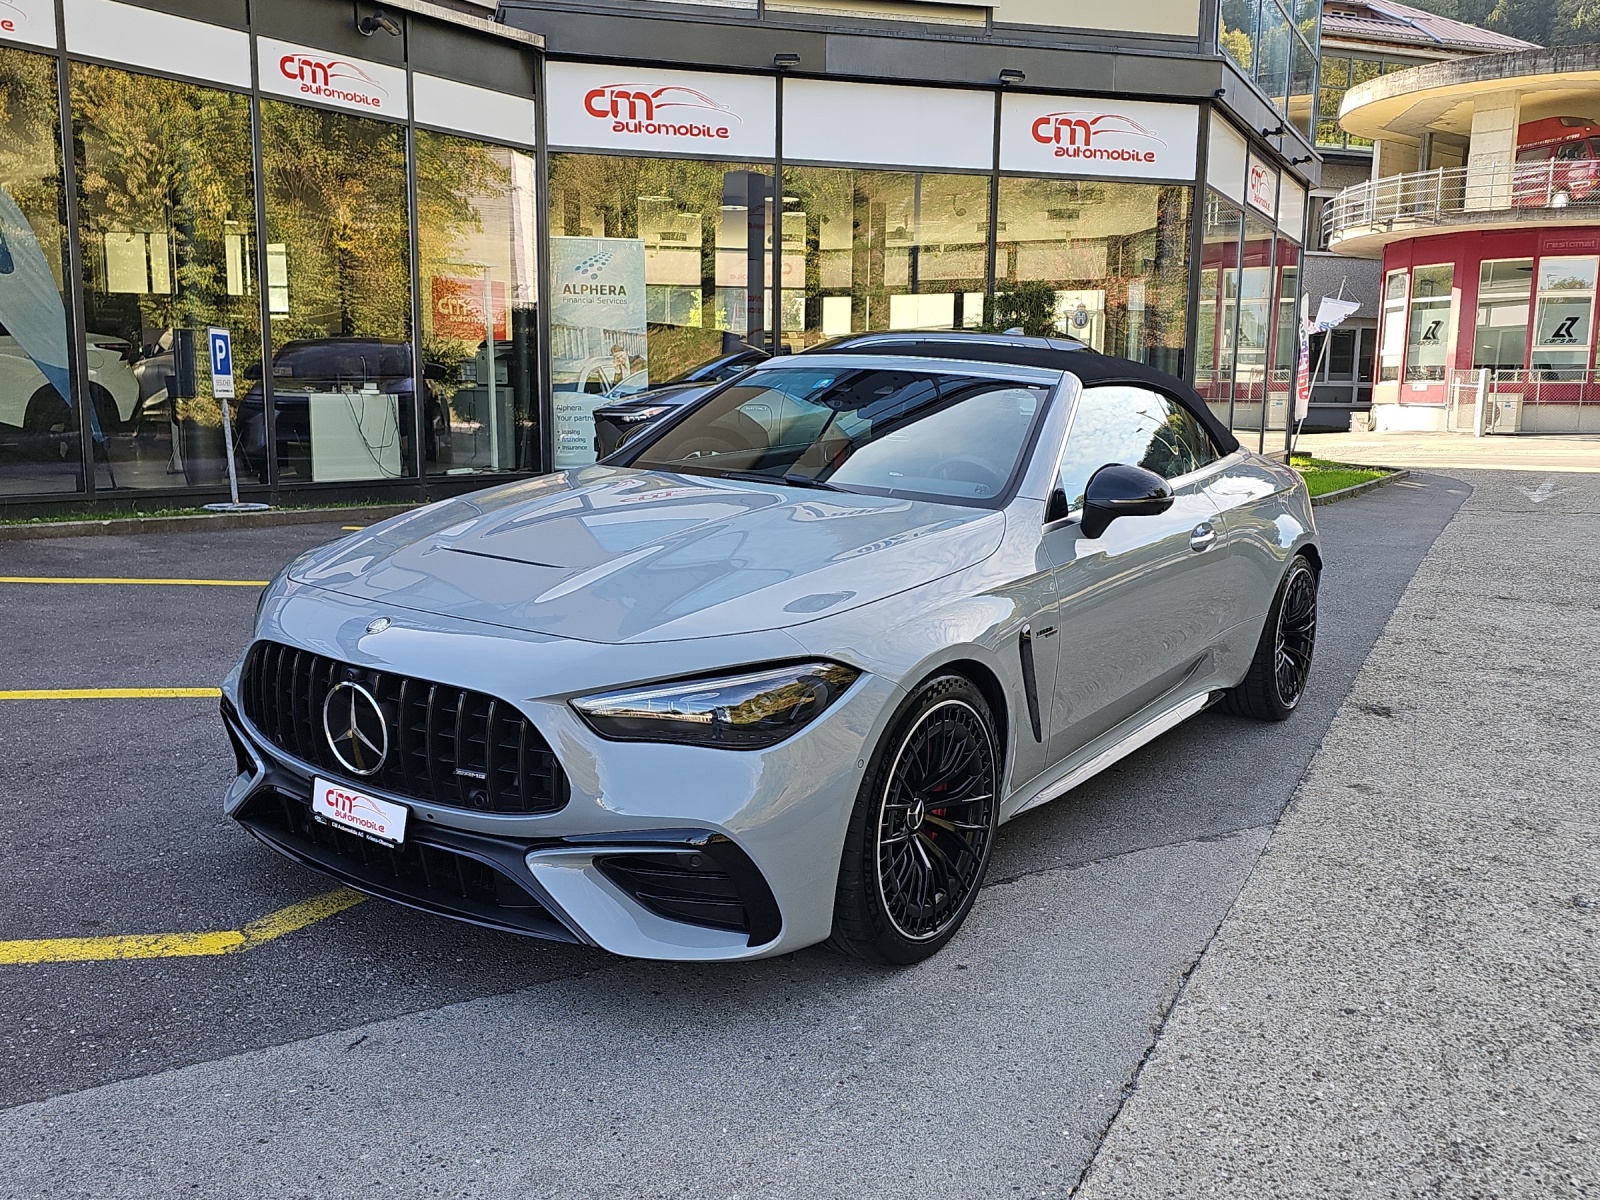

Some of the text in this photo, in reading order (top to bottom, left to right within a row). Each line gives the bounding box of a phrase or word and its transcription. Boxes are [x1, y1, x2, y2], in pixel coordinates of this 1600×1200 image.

[300, 83, 381, 107] automobile
[612, 121, 729, 139] automobile
[1054, 146, 1155, 163] automobile
[1546, 240, 1595, 249] restomat
[563, 284, 627, 297] ALPHERA
[563, 296, 628, 305] Financial Services
[215, 338, 226, 371] P
[556, 404, 584, 412] Alphera.
[334, 809, 385, 833] automobile
